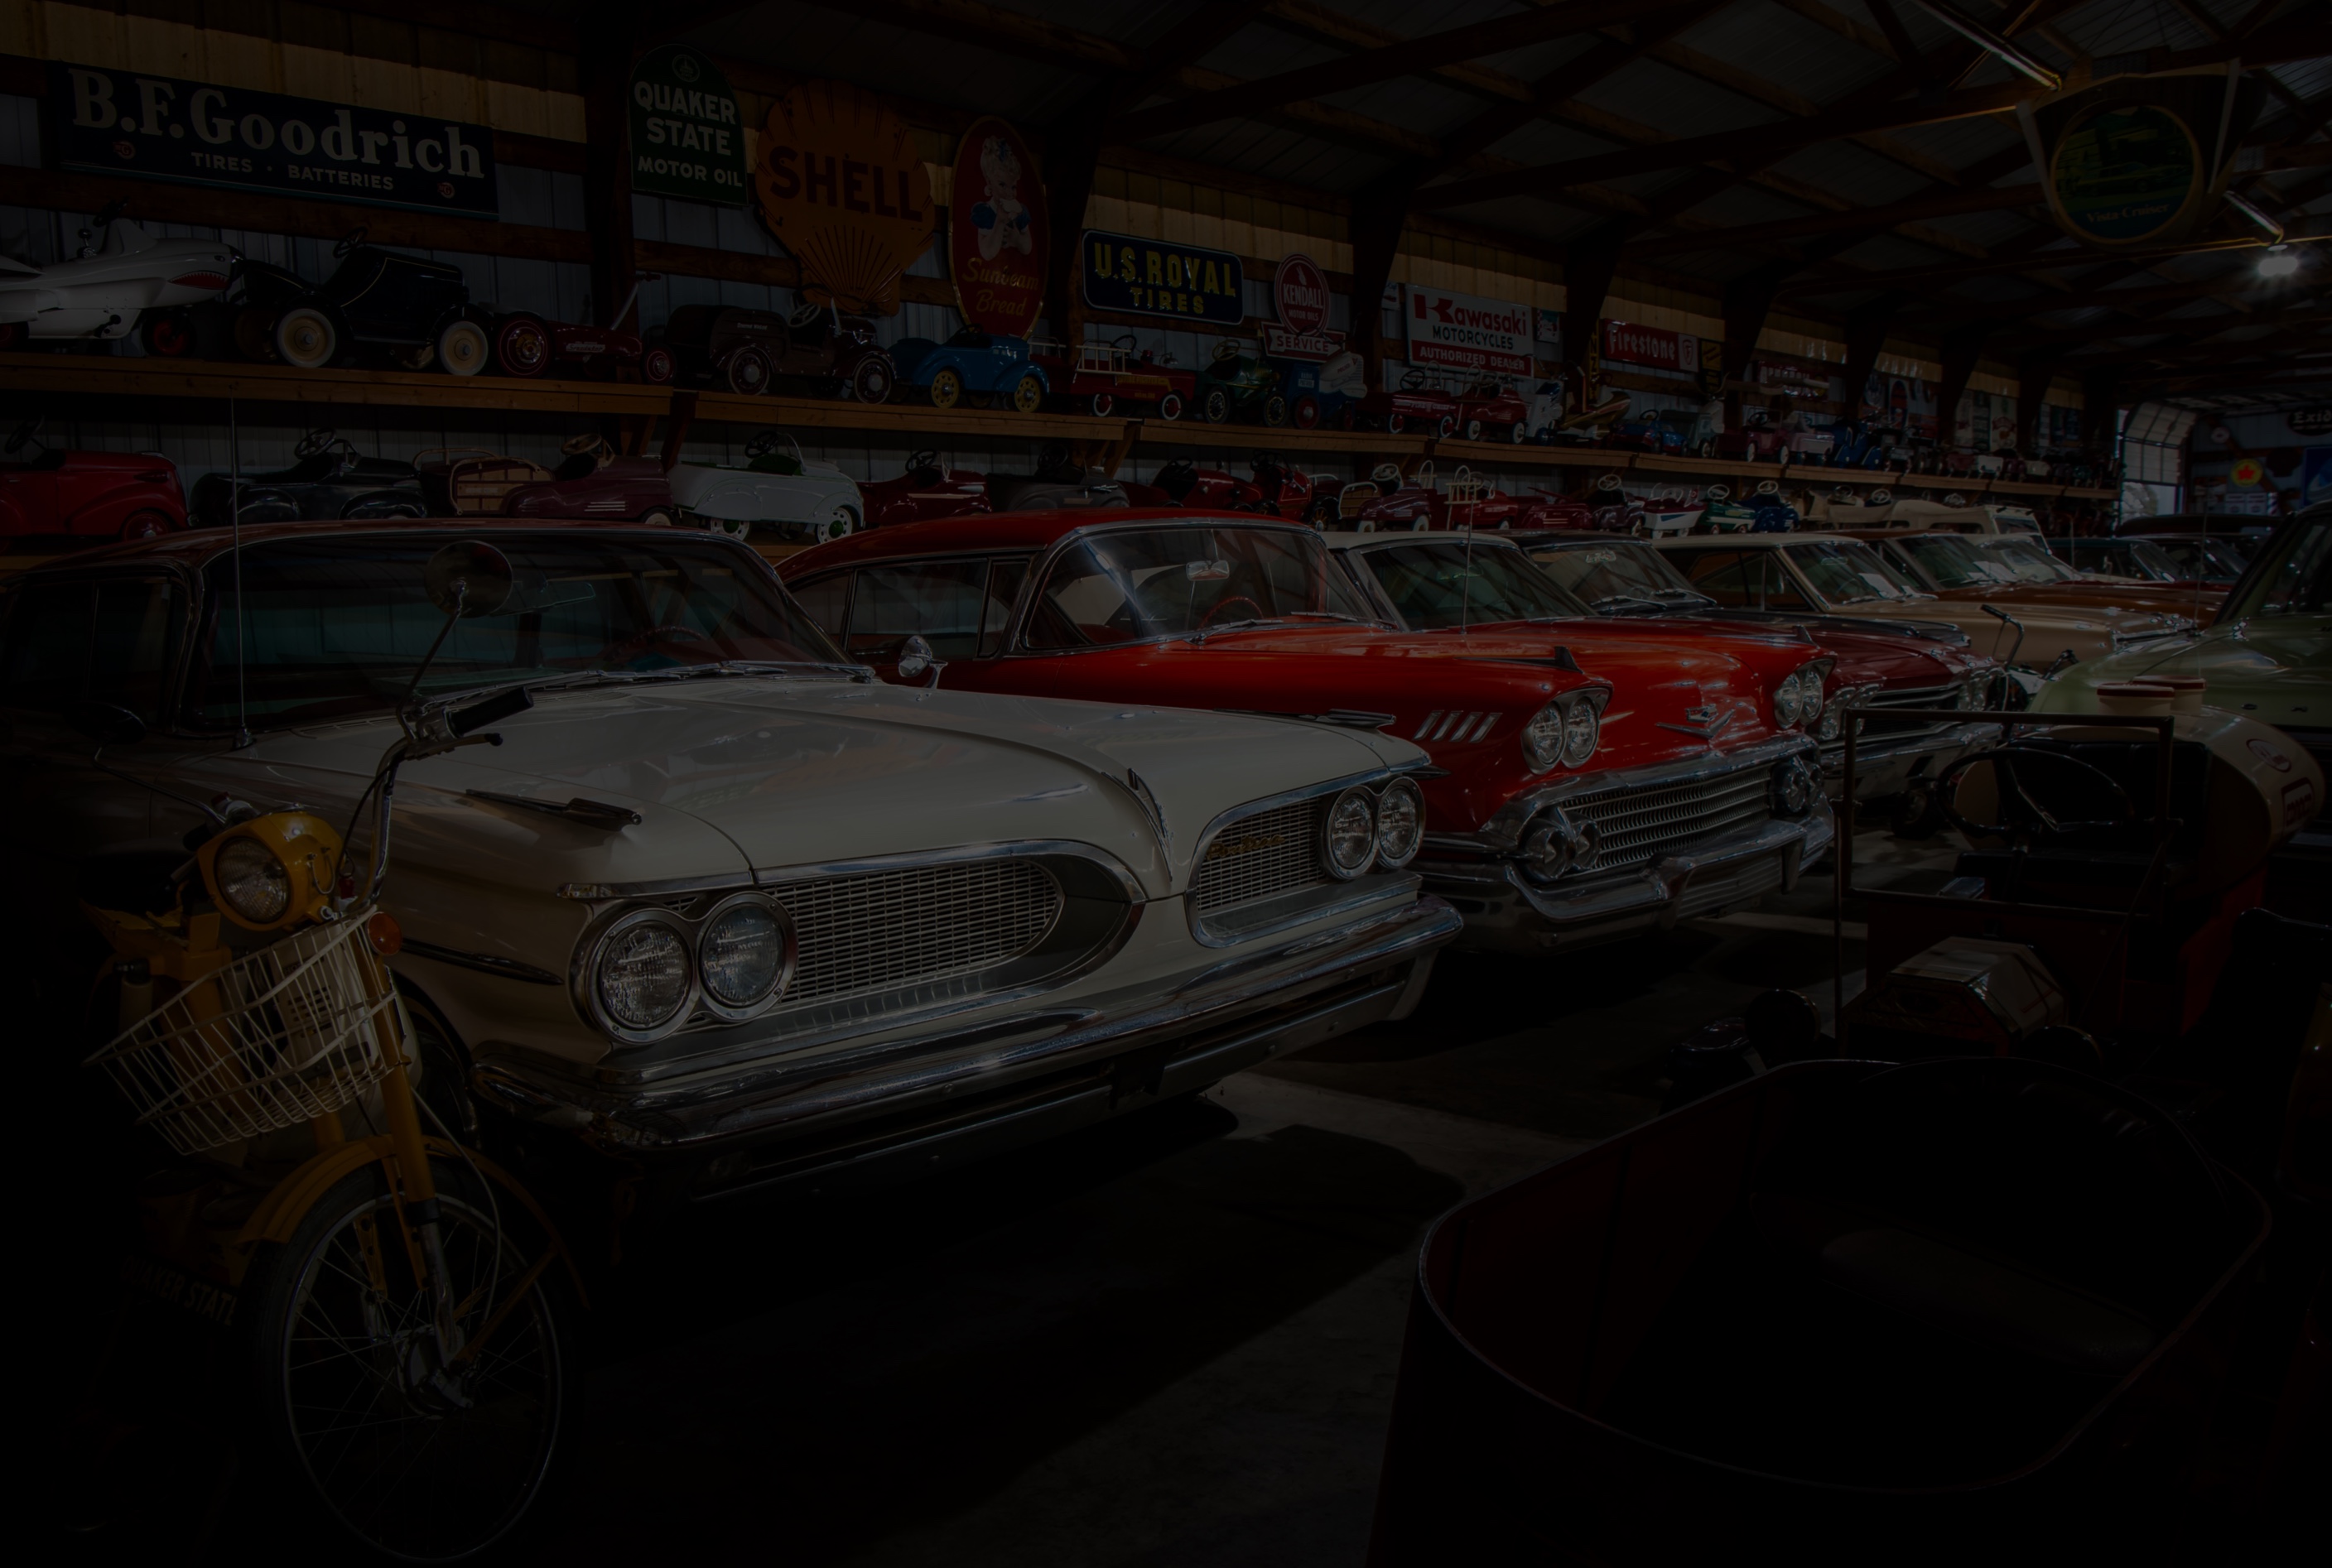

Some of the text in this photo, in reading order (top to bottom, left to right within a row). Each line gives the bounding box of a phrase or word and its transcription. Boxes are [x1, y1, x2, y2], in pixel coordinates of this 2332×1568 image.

[634, 80, 736, 125] QUAKER
[646, 118, 732, 156] STATE
[190, 151, 395, 191] TIRES BATTERIES
[637, 155, 744, 188] MOTOR OIL
[768, 145, 923, 223] SHELL
[961, 257, 1039, 291] Sunbeam
[1145, 250, 1236, 298] ROYAL
[976, 288, 1028, 316] Bread
[1129, 286, 1205, 315] TIRES
[1283, 283, 1324, 310] KENDALL
[1289, 308, 1319, 322] MOTOR OILS
[1413, 292, 1527, 337] Kawasaki
[1277, 334, 1329, 353] SERVICE
[1432, 324, 1514, 350] MOTORCYCLES
[1606, 323, 1684, 361] Firestone
[1419, 345, 1525, 372] AUTHORIZED DEALER
[119, 1254, 186, 1304] QUAKER
